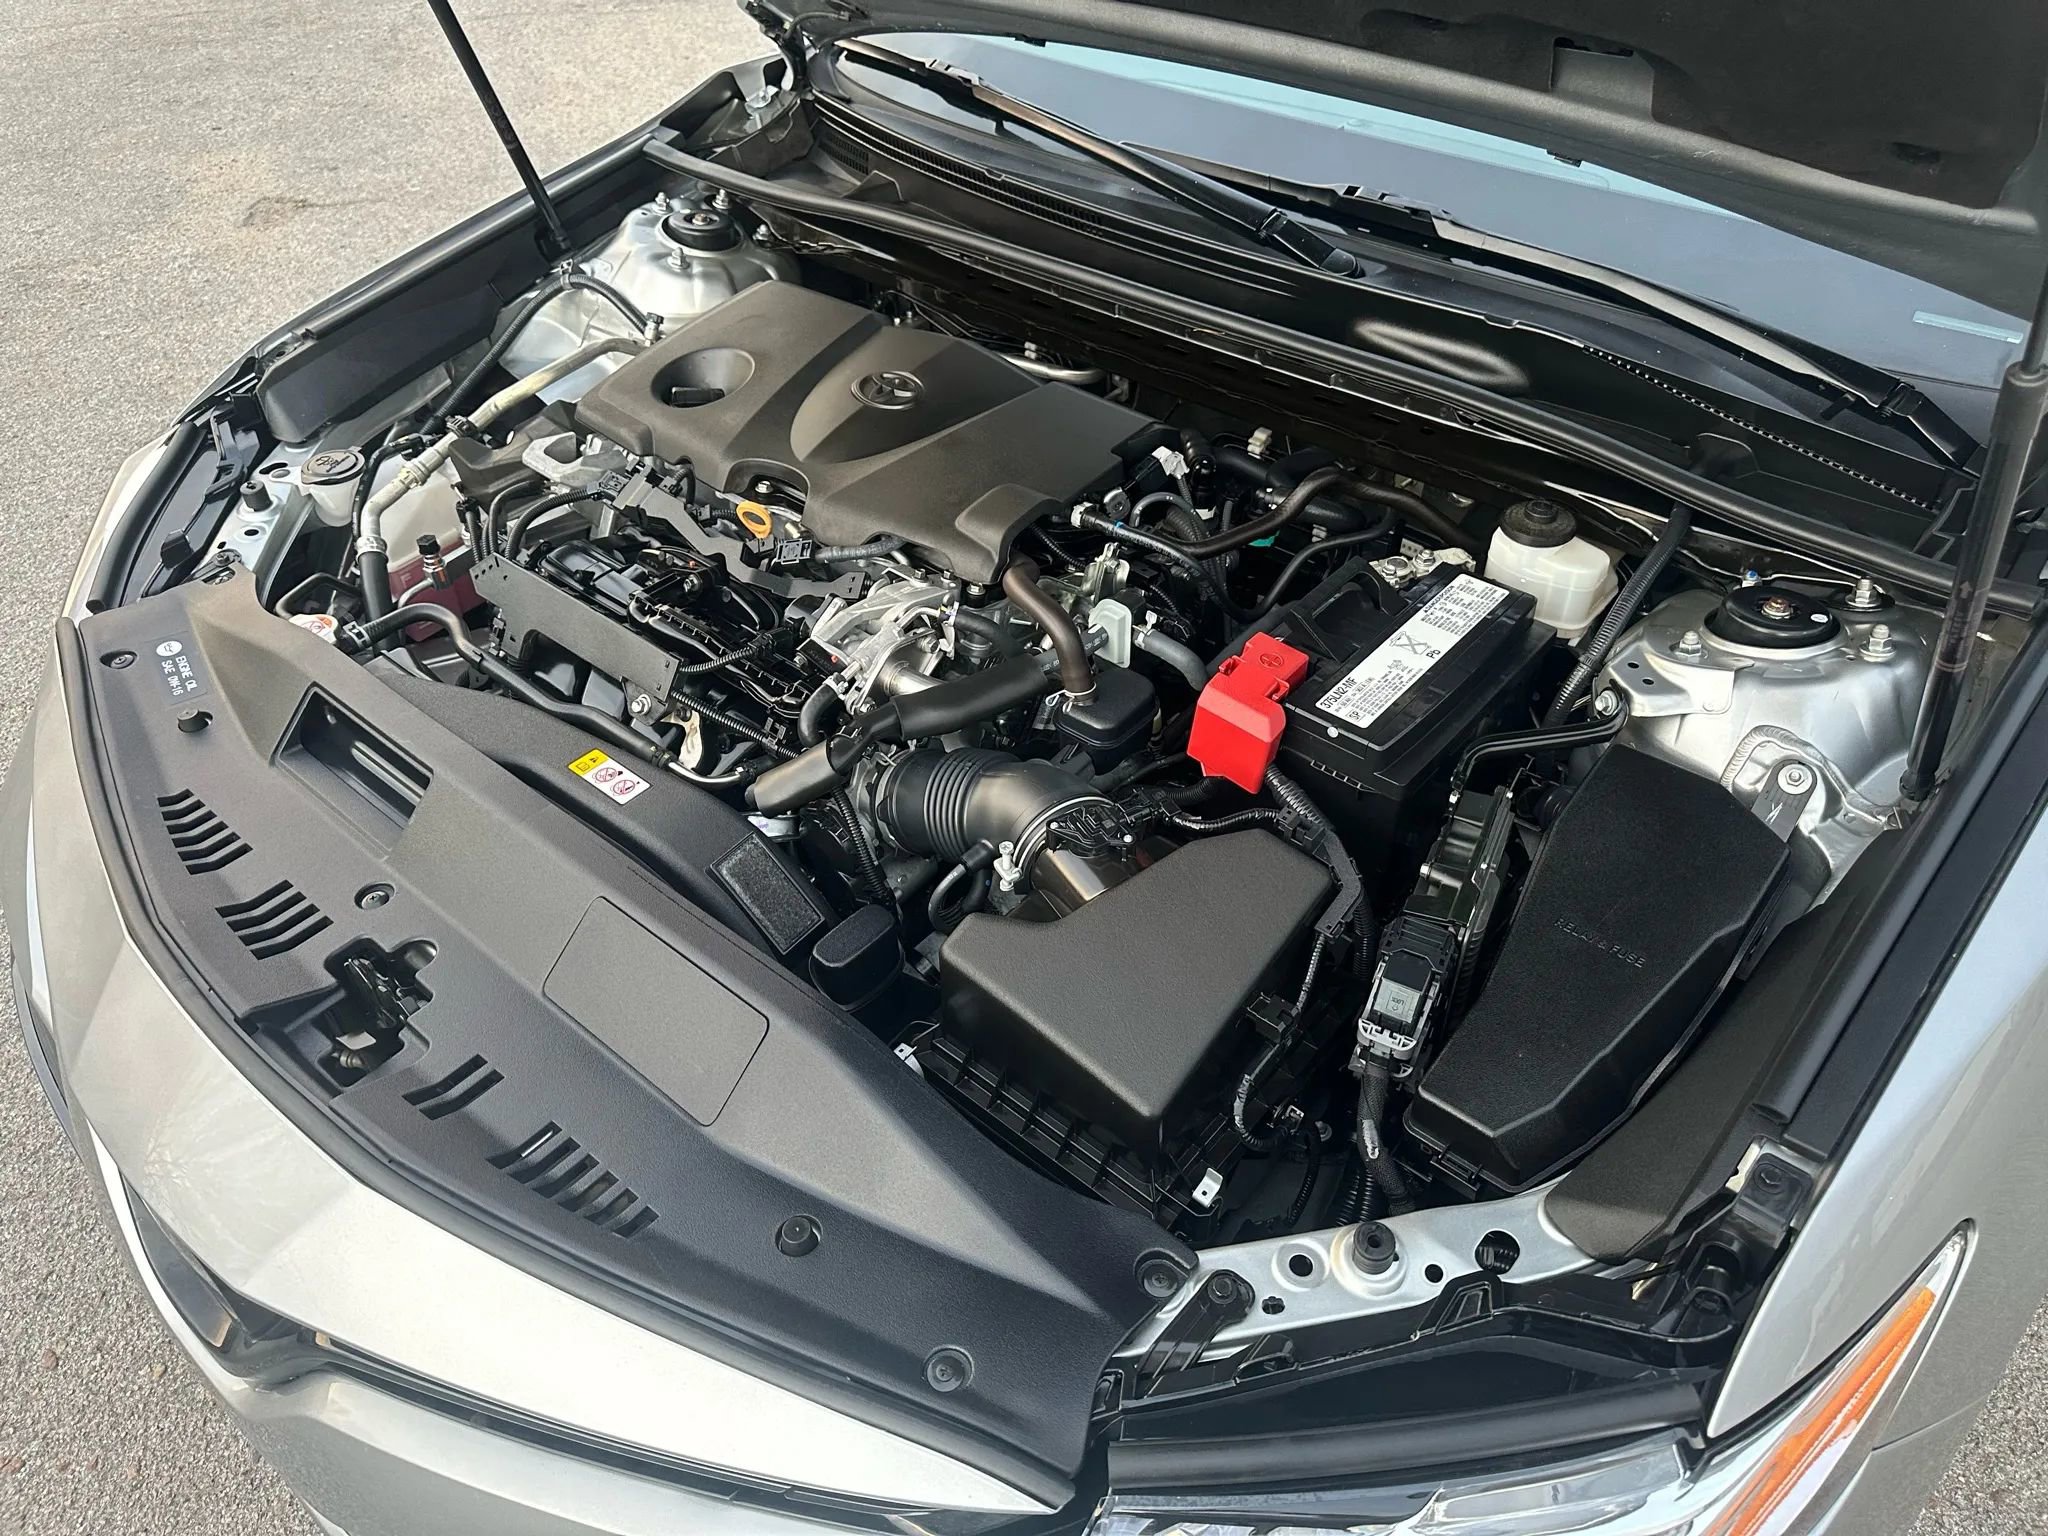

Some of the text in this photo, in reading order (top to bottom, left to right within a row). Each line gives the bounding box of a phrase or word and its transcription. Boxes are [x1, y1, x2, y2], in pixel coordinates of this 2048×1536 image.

[1426, 649, 1441, 659] Pb
[161, 659, 184, 696] SAE 0W-16
[175, 655, 198, 692] ENGINE OIL
[1320, 676, 1358, 709] 375LN2-MF
[1553, 917, 1599, 943] RELAY
[1608, 943, 1646, 968] FUSE
